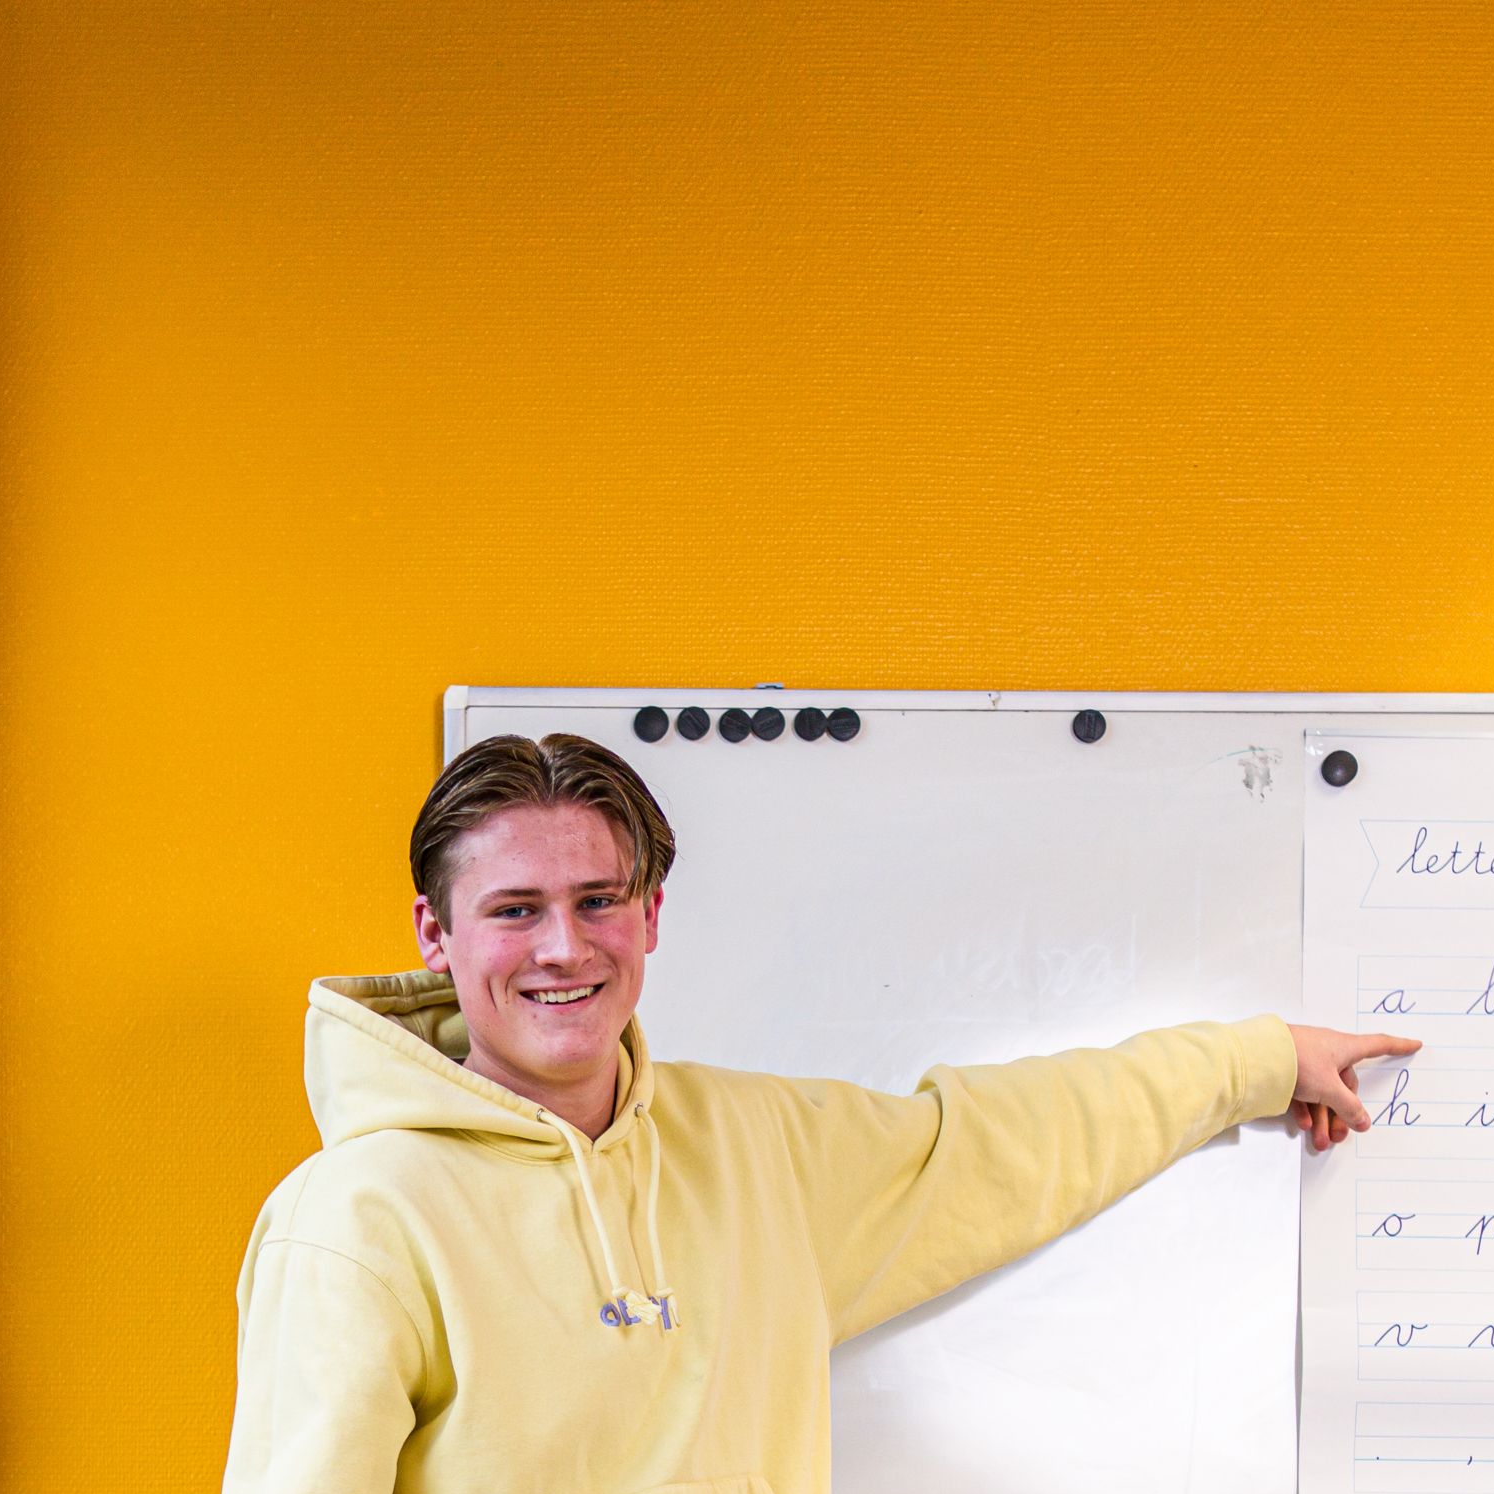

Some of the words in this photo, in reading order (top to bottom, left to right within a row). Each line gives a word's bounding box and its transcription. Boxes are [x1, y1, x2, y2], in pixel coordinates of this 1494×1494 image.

[1372, 988, 1416, 1015] a
[1372, 1068, 1421, 1127] h
[1372, 1213, 1416, 1238] o
[1374, 1323, 1429, 1348] v
